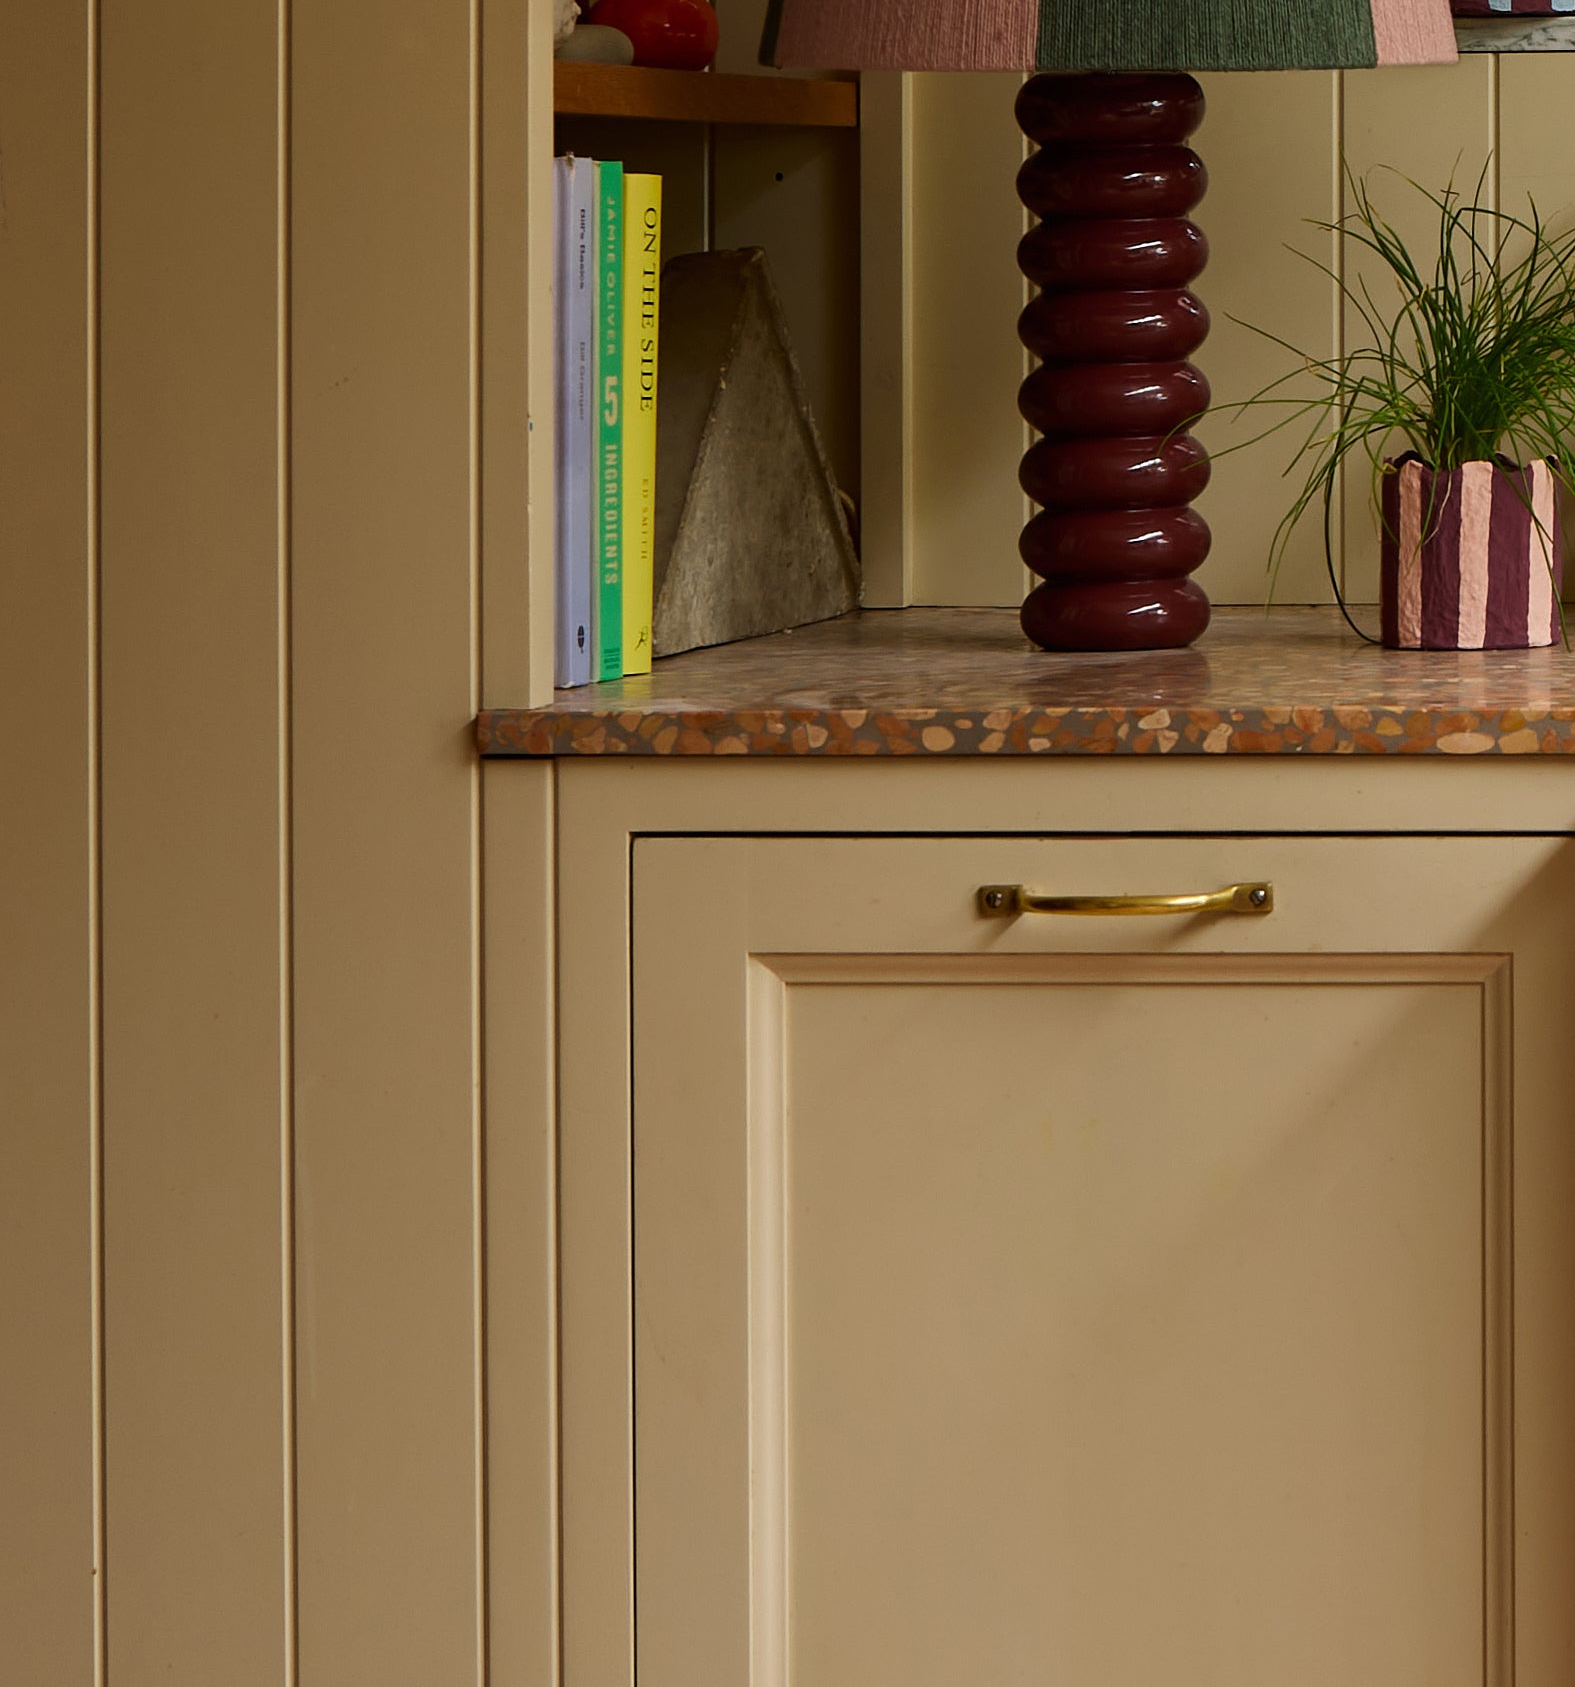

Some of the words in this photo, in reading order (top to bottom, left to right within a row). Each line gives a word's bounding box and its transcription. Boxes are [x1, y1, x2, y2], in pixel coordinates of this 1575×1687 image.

[607, 196, 616, 264] JAMIE
[643, 208, 657, 253] ON
[606, 270, 616, 355] OLIVER
[641, 264, 656, 329] THE
[604, 376, 619, 427] 5
[640, 339, 654, 412] SIDE
[604, 444, 619, 584] INGREDIENTS
